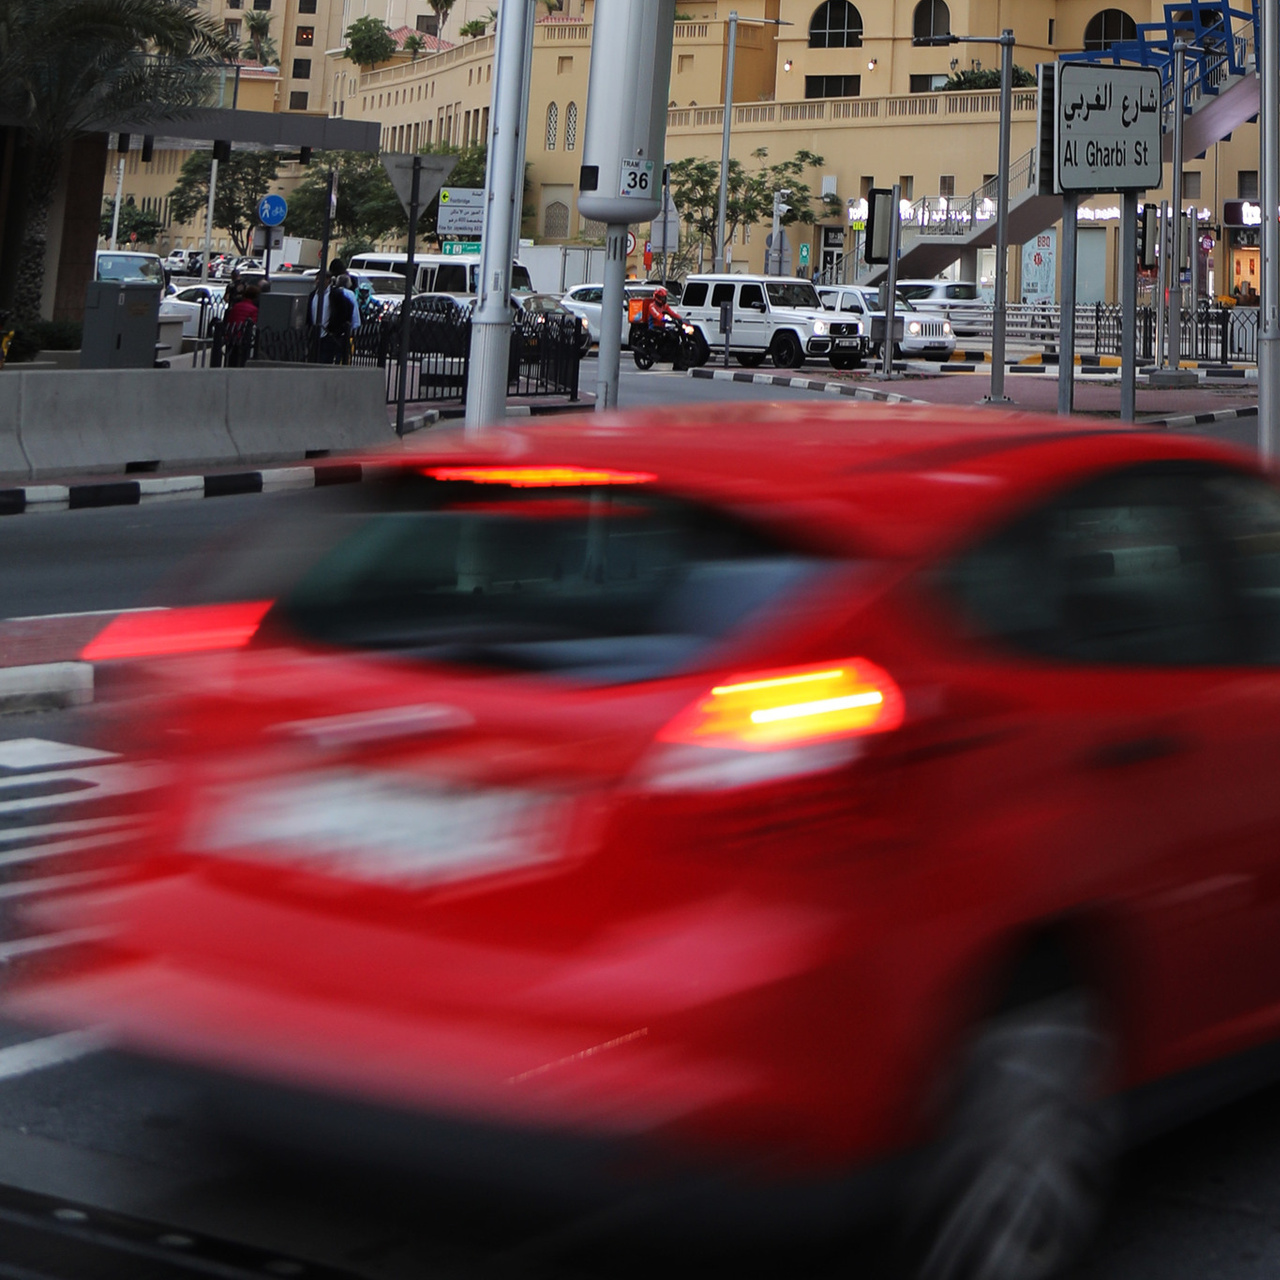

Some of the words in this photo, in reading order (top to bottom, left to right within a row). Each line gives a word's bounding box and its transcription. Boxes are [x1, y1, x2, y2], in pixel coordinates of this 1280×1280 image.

[1064, 81, 1112, 130] الغربي
[1121, 85, 1158, 128] شارع
[623, 160, 640, 168] TRAM
[1064, 140, 1078, 167] Al
[1086, 140, 1126, 167] Gharbi
[1134, 140, 1148, 166] St
[627, 171, 649, 190] 36
